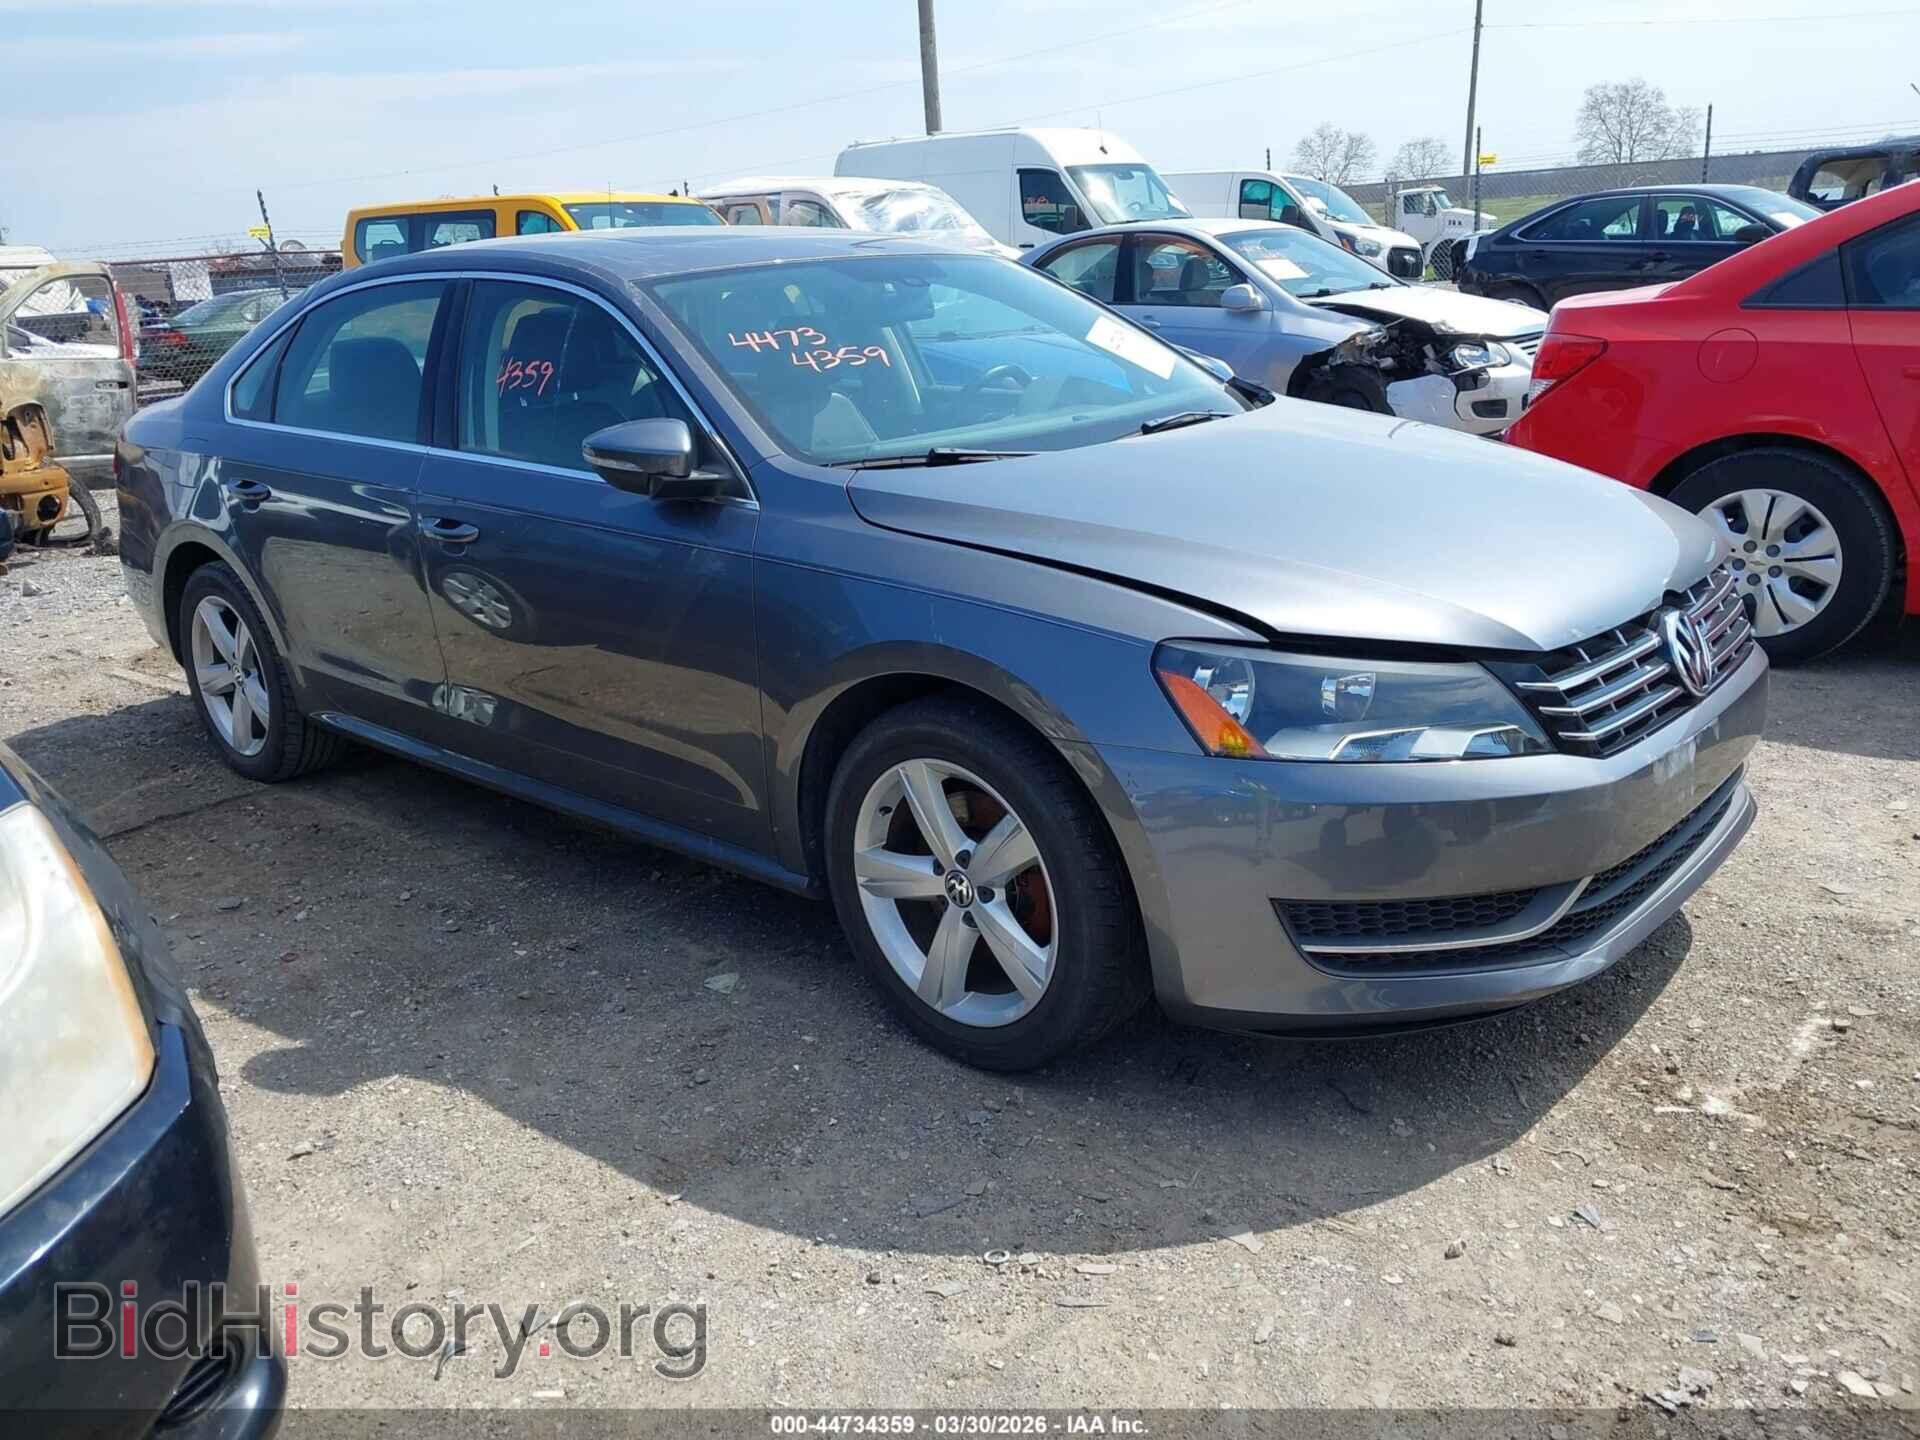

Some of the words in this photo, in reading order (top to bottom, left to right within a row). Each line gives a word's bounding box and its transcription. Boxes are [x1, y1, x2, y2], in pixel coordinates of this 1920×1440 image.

[728, 327, 826, 352] 4473
[791, 346, 890, 373] 4359
[496, 356, 554, 398] 4359
